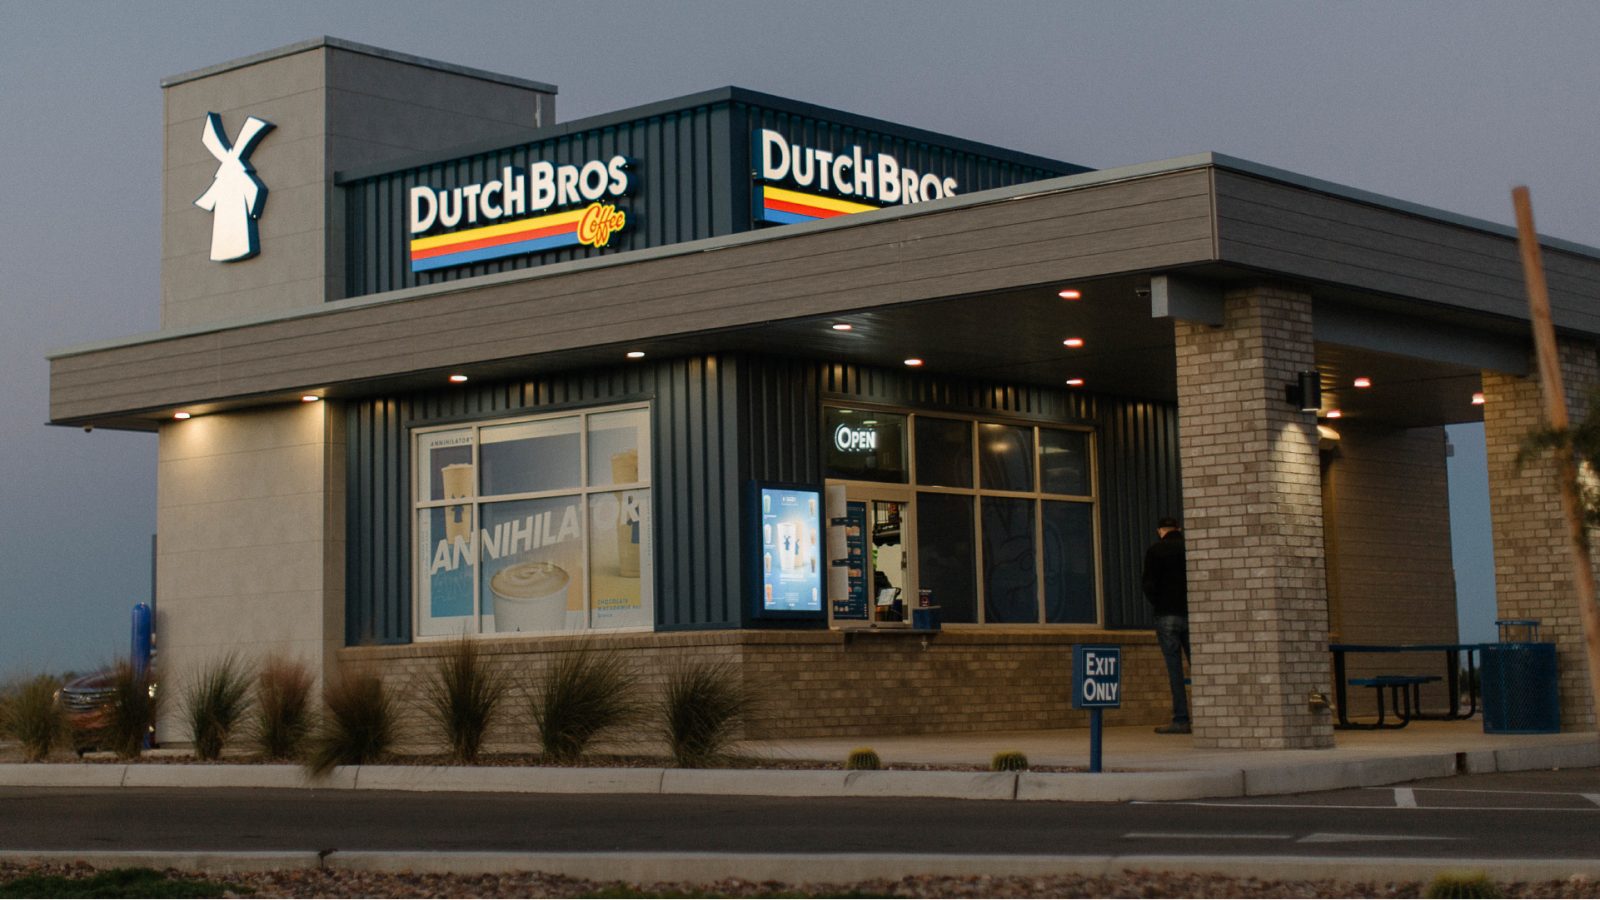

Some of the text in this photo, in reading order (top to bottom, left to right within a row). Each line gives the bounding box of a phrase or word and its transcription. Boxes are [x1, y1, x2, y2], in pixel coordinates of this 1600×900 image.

[531, 155, 628, 210] BROS
[579, 203, 625, 246] Coffee
[838, 427, 877, 449] OPEN
[431, 492, 640, 575] ANNIHILAOR
[1086, 652, 1116, 676] EXIT
[1083, 678, 1118, 701] ONLY
